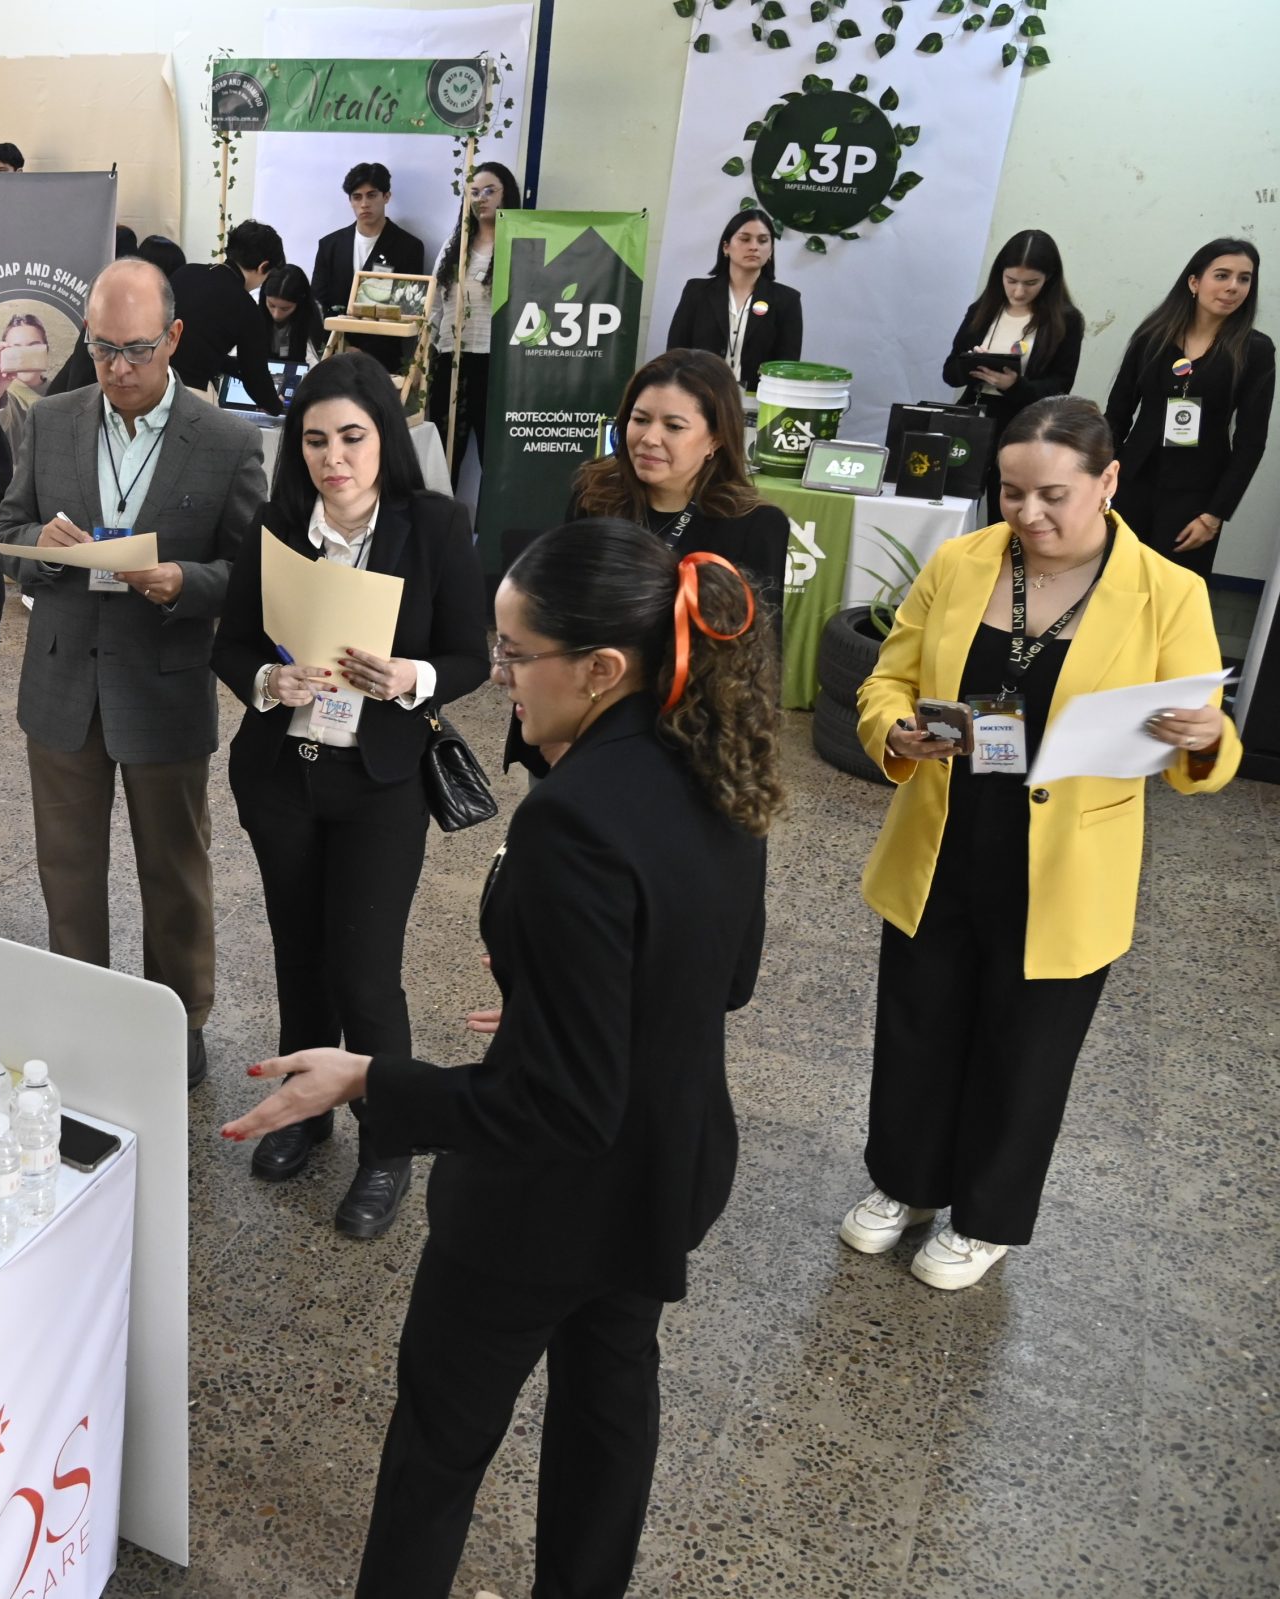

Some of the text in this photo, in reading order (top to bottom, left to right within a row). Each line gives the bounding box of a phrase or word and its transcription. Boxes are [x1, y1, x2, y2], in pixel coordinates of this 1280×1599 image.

[464, 72, 476, 84] CARE
[212, 78, 263, 107] SOAP AND SHAMPOO
[771, 142, 877, 184] A3P
[784, 183, 858, 195] IMPERMEABILIZANTE
[24, 262, 51, 278] AND
[53, 268, 89, 298] SHAM
[509, 302, 622, 347] A3P
[524, 349, 604, 358] IMPERMEABILIZANTE
[505, 410, 606, 423] PROTECCIÓN TOTA
[509, 426, 534, 437] CON
[523, 442, 583, 453] AMBIENTAL
[949, 447, 967, 458] 3P
[825, 459, 865, 476] A3P
